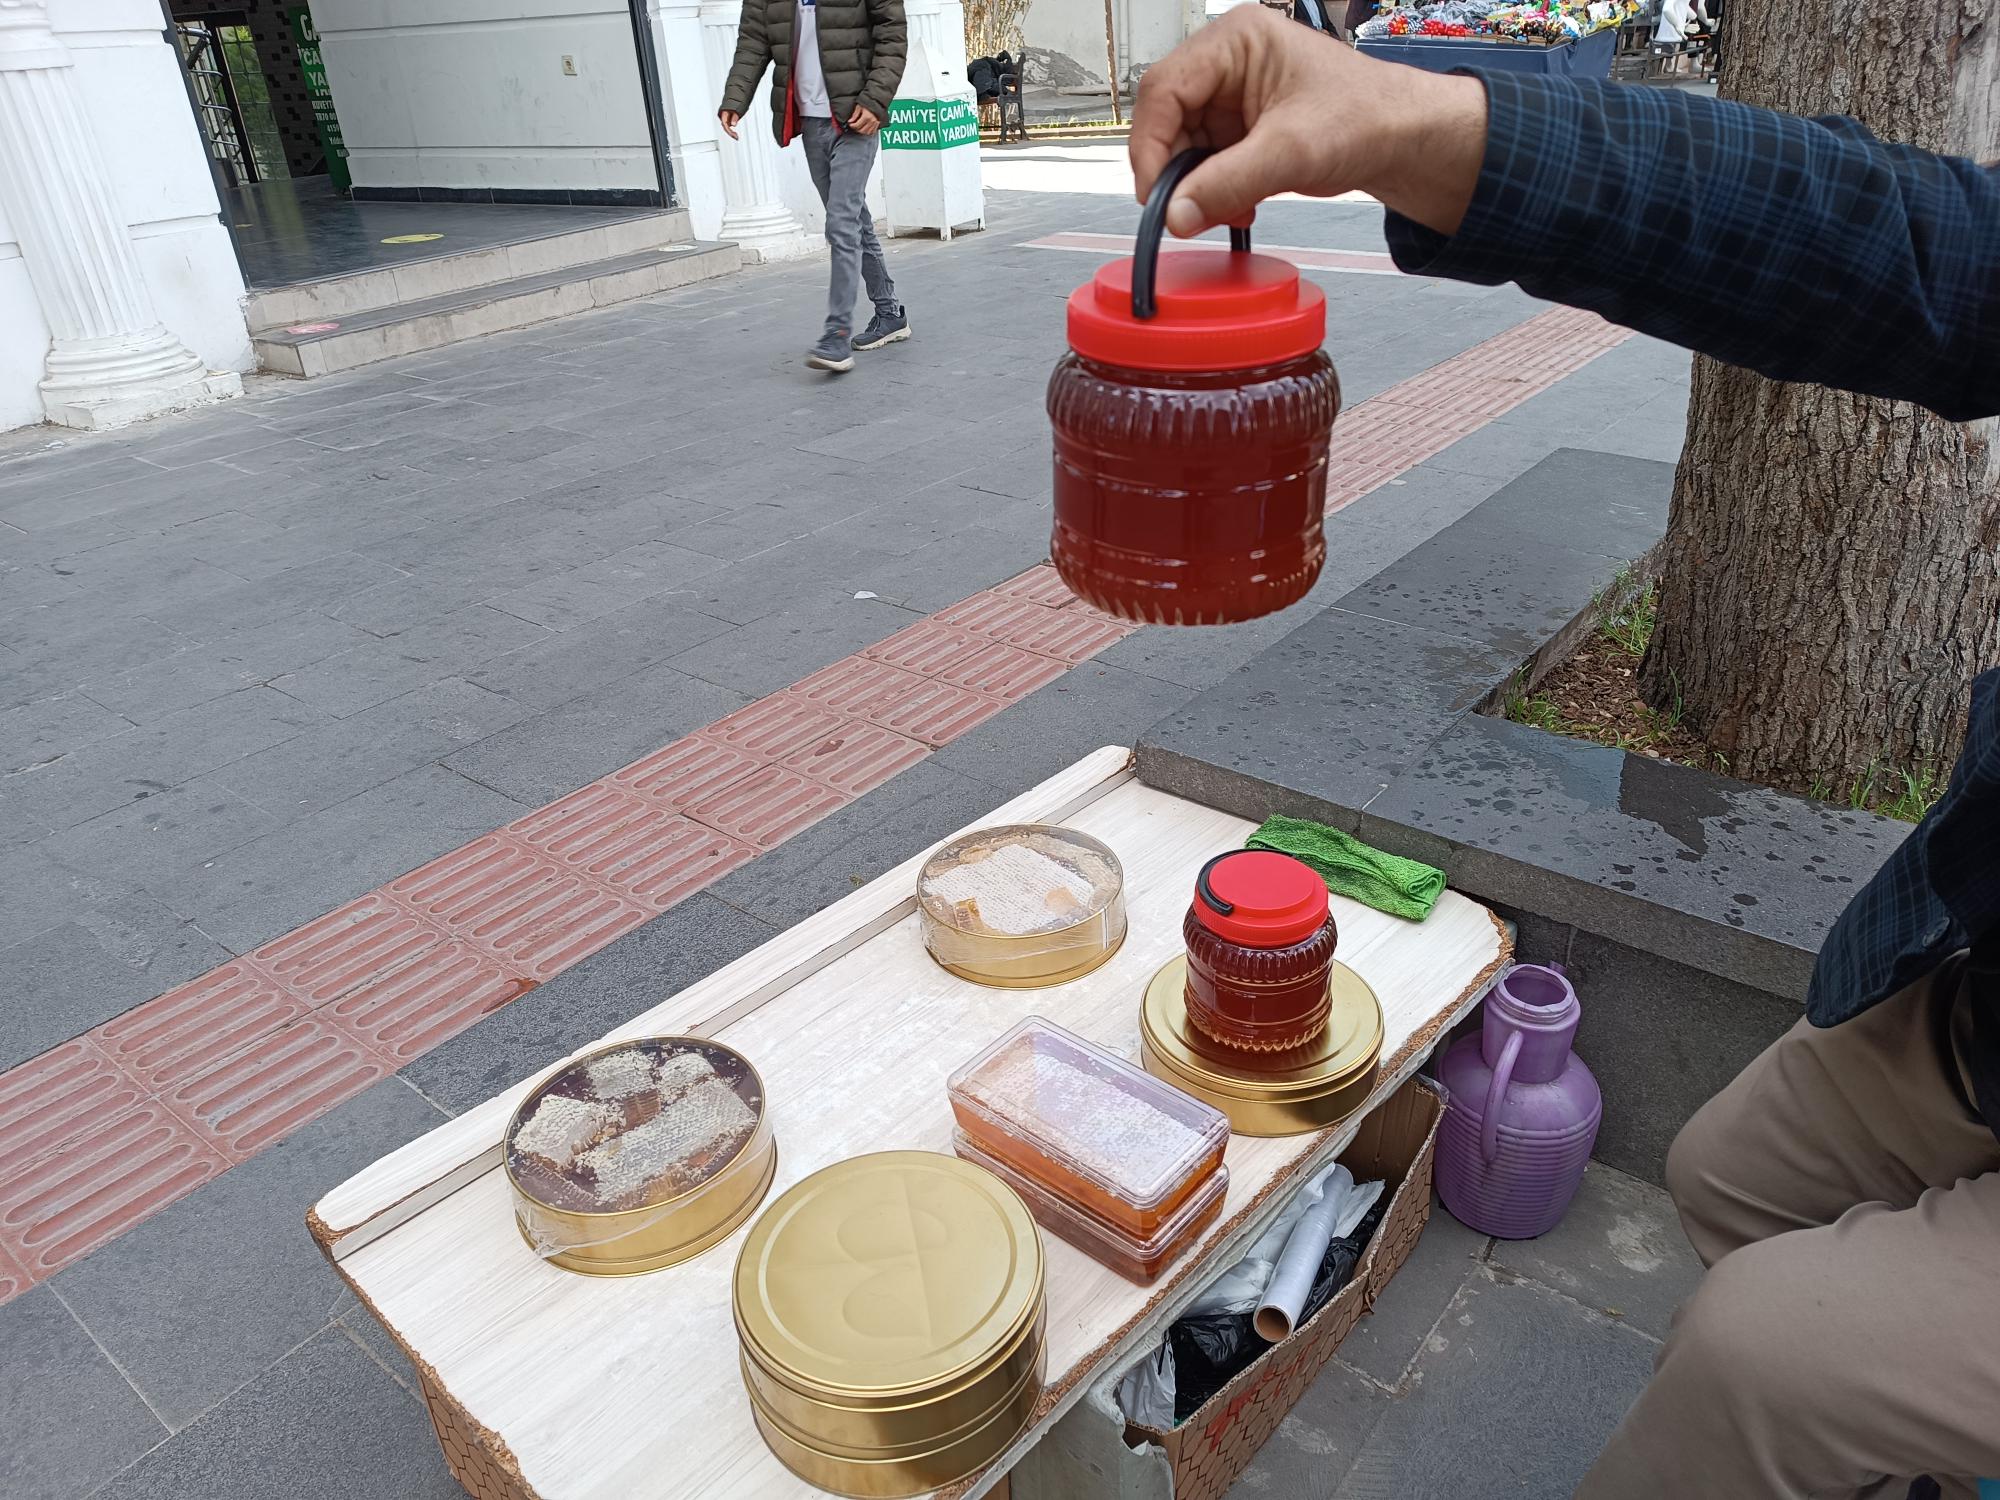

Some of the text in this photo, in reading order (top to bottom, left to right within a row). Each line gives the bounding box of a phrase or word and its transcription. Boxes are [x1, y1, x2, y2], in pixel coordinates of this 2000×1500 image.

[888, 106, 937, 124] AMİ'YE
[883, 130, 937, 144] YARDIM
[942, 122, 977, 142] YARDIM
